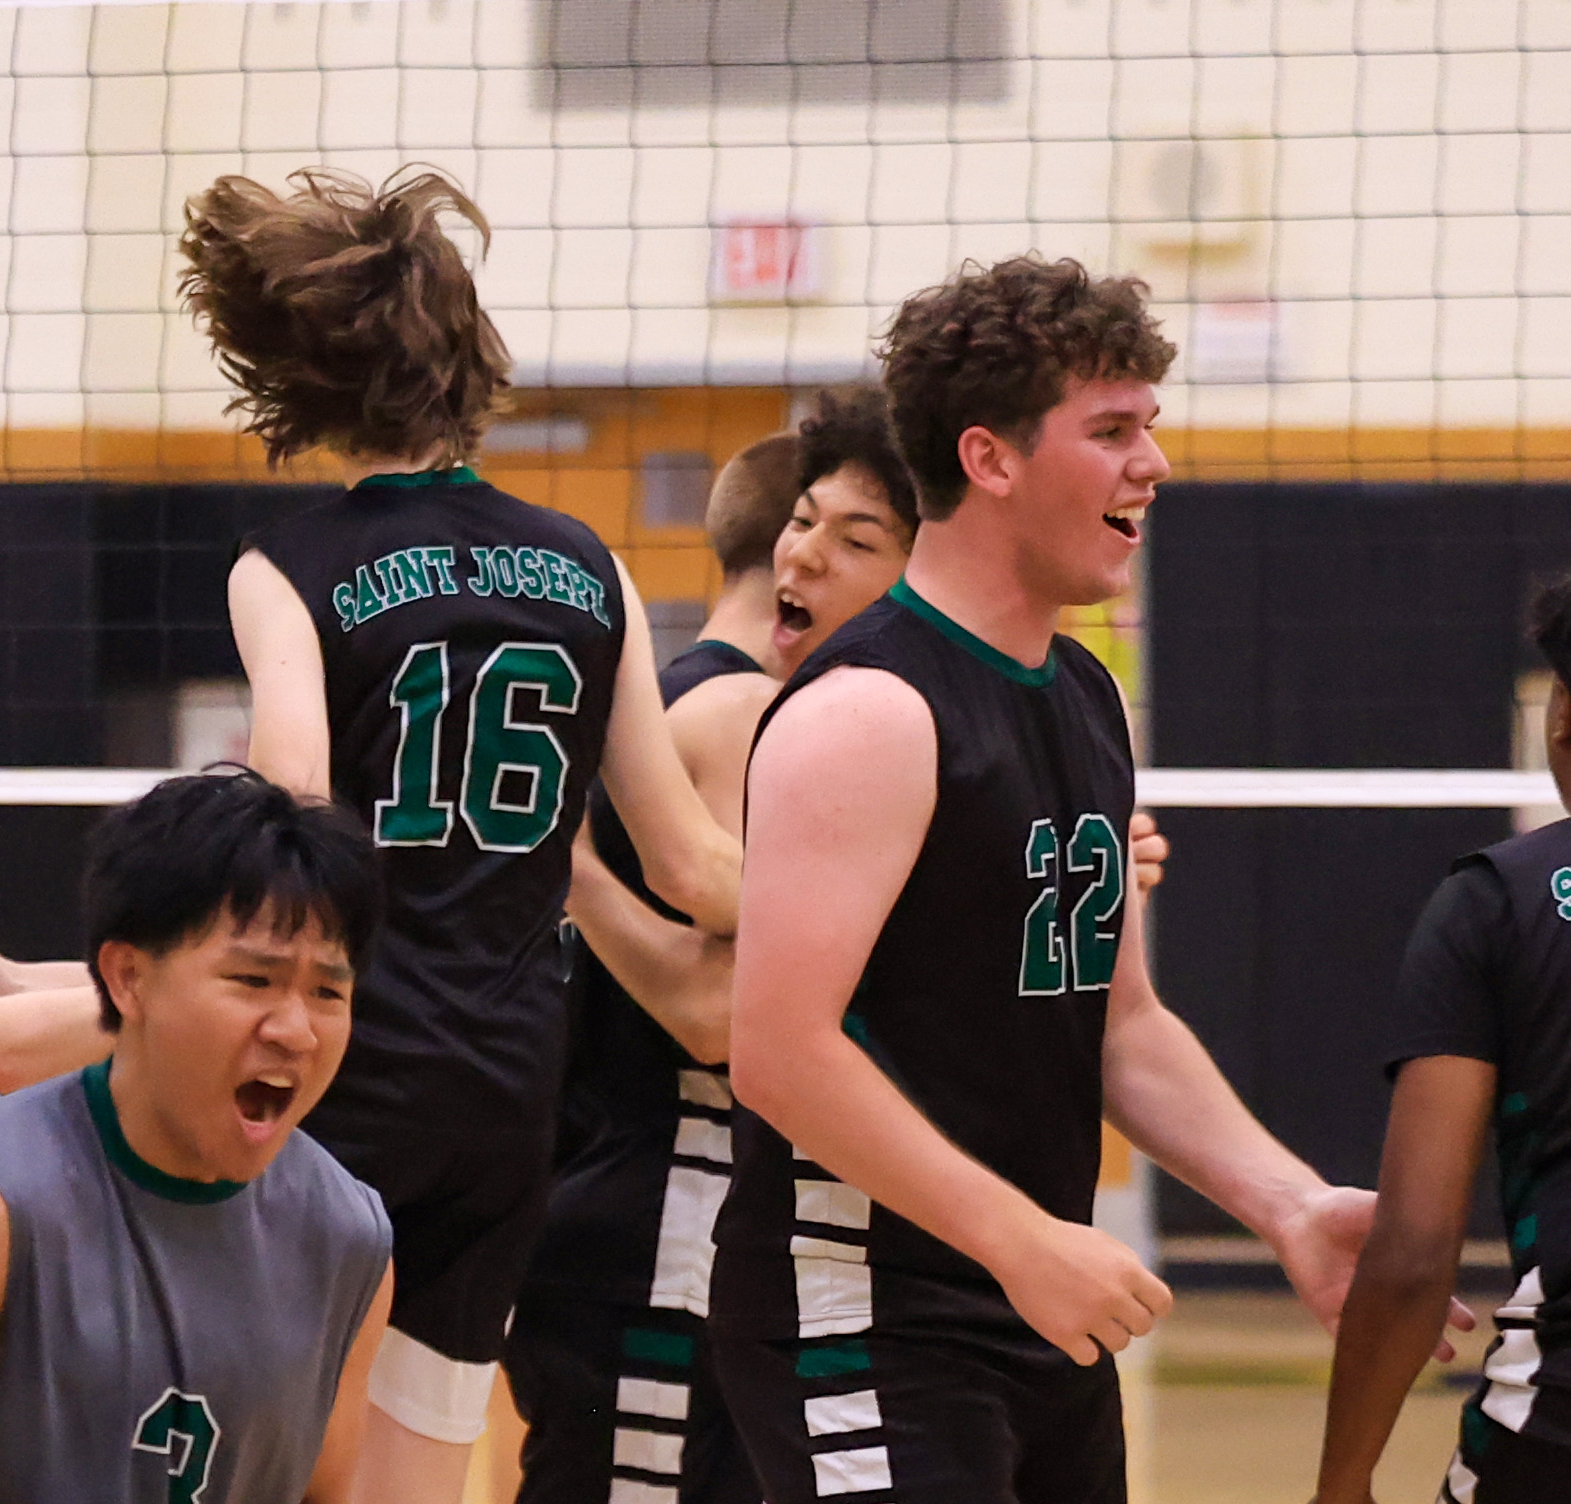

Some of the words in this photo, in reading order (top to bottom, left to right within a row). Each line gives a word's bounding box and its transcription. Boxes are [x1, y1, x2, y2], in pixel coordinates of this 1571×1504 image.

[333, 546, 460, 632] SAINT
[374, 640, 582, 853] 16
[1018, 813, 1123, 997] 22
